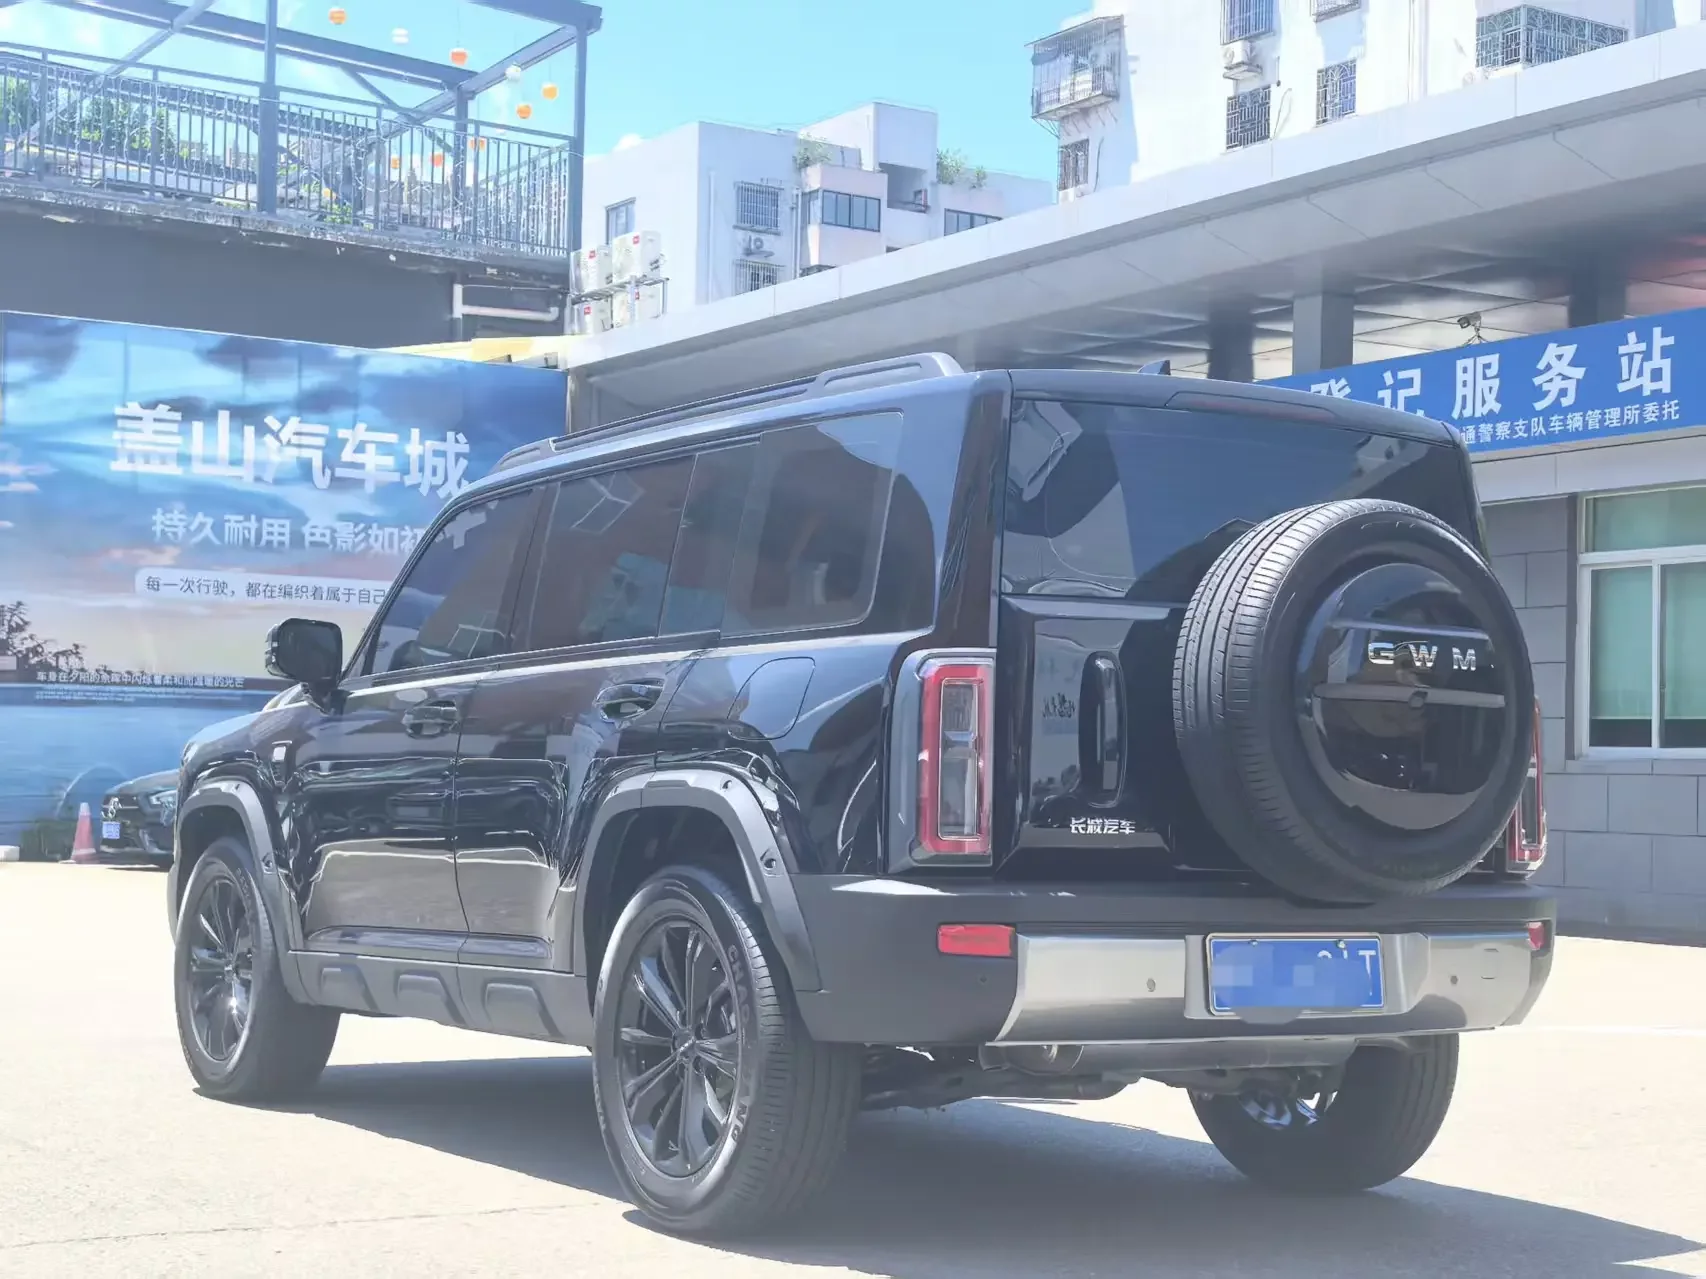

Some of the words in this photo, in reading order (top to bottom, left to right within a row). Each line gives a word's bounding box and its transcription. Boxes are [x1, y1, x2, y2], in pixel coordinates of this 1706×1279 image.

[110, 402, 470, 498] 盖山汽车城
[152, 508, 290, 549] 持久耐用
[1368, 642, 1476, 671] GWM
[1070, 817, 1136, 834] 长城汽车
